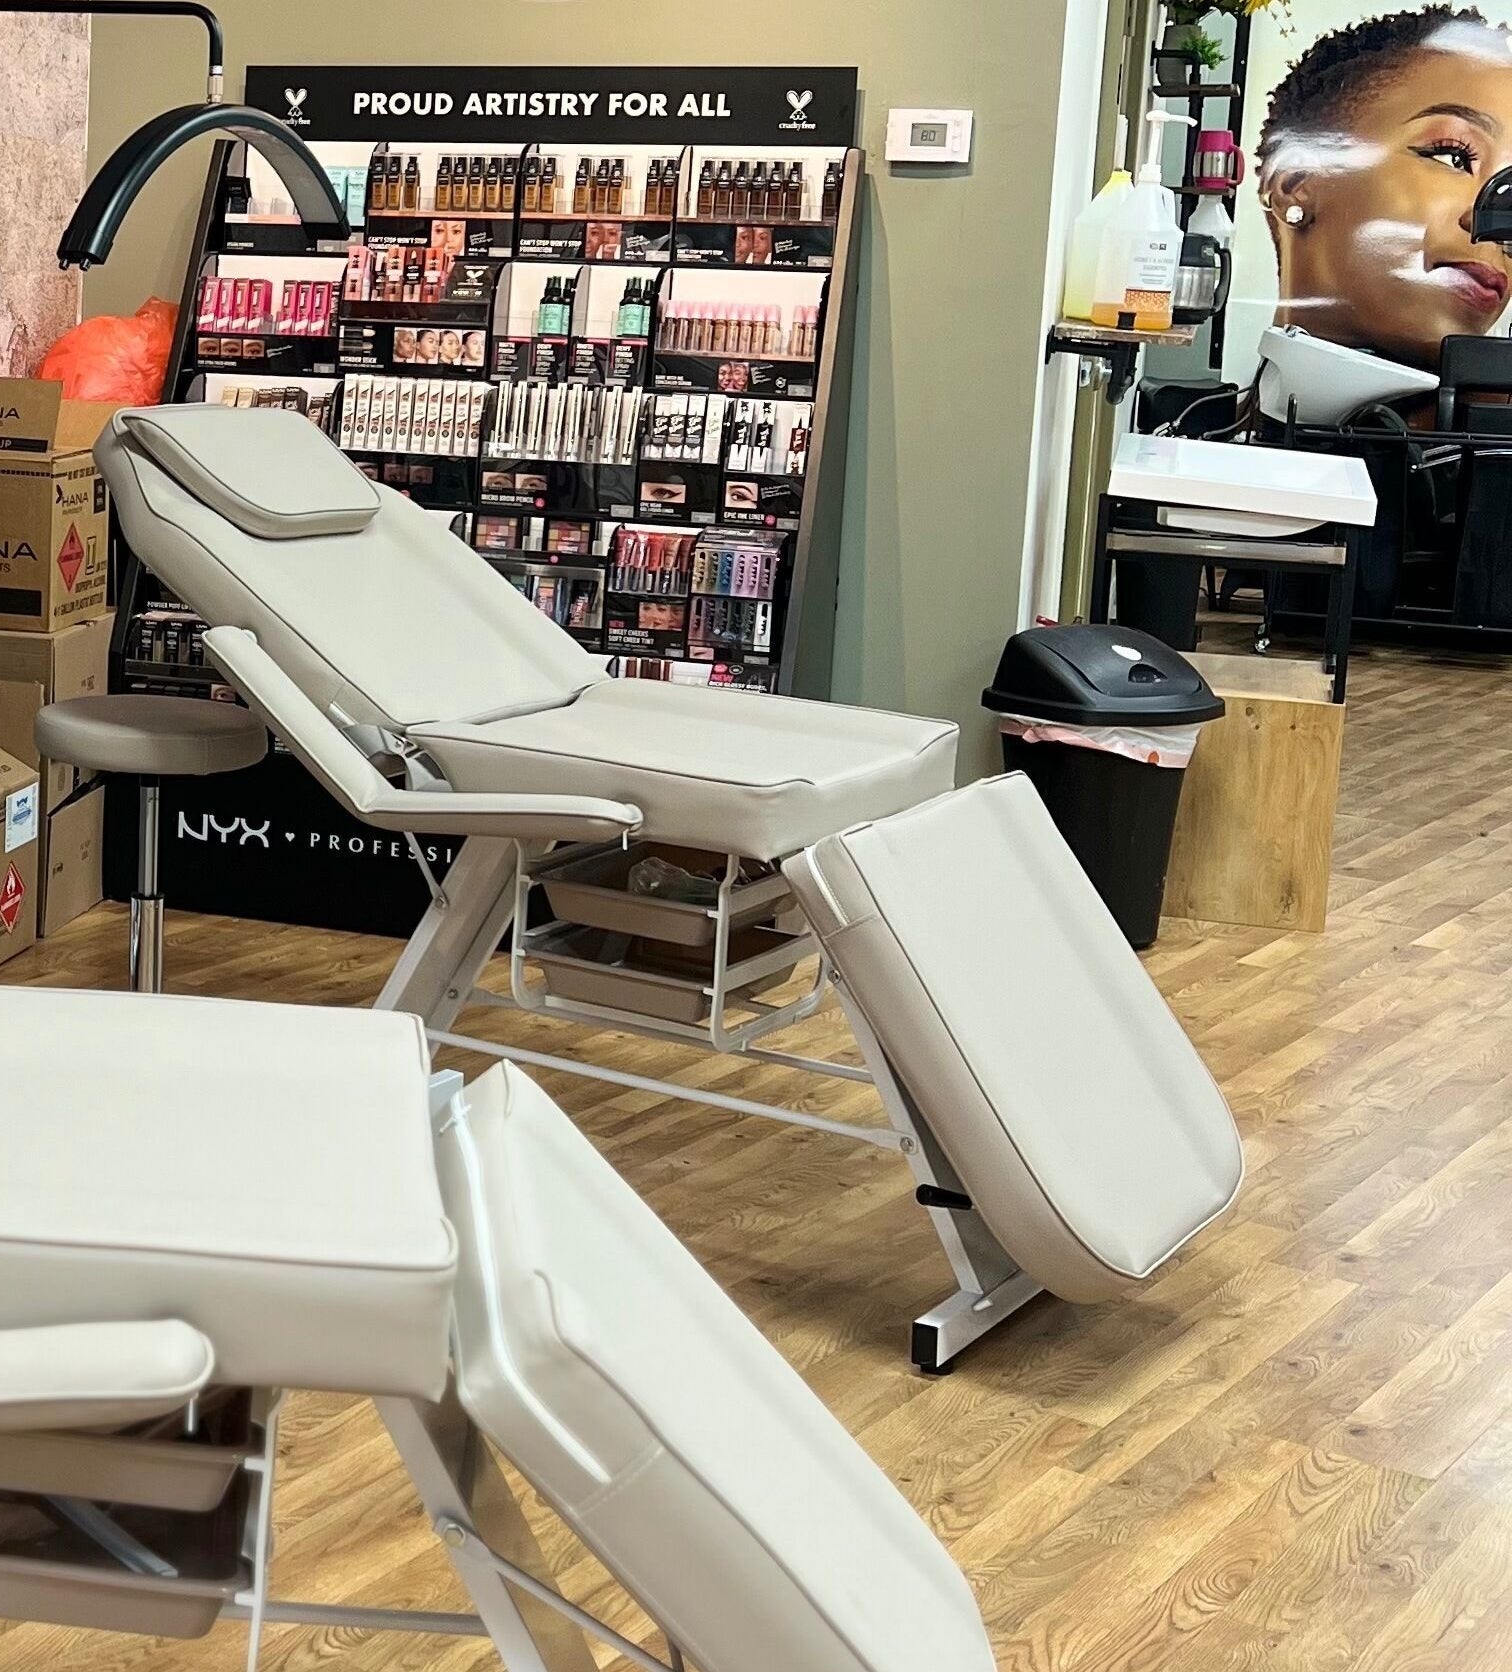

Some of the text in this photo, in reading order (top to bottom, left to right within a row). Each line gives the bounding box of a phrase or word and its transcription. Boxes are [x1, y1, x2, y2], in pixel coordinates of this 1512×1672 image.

[352, 92, 731, 117] PROUD ARTISTRY FOR ALL
[61, 491, 90, 508] HANA
[177, 810, 271, 848] NYX
